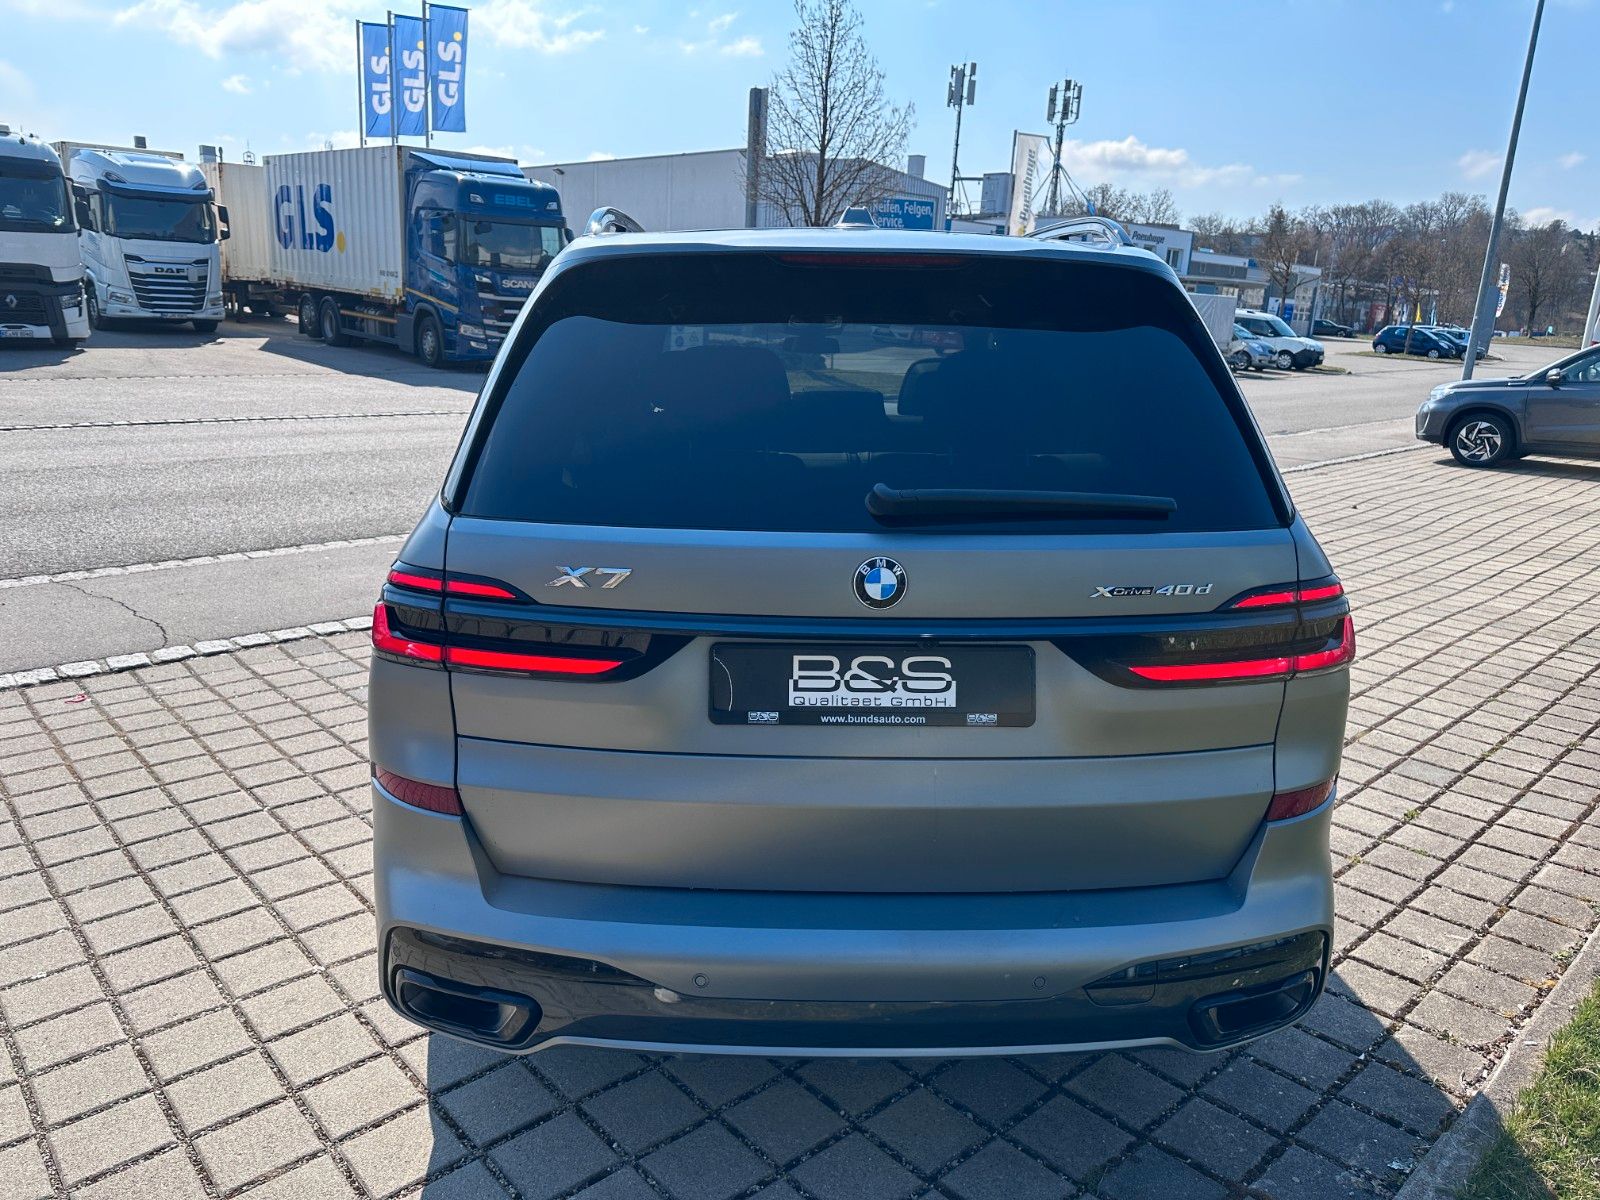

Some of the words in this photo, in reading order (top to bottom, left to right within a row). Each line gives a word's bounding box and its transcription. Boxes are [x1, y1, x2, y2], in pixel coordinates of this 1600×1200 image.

[494, 193, 536, 208] EBEL
[904, 201, 933, 218] Felgen,
[154, 266, 186, 274] DAF
[859, 558, 903, 576] BMW
[544, 565, 633, 589] X7
[792, 654, 953, 694] B&S
[793, 694, 882, 707] Qualitaet
[820, 713, 926, 725] www.bundsauto.com
